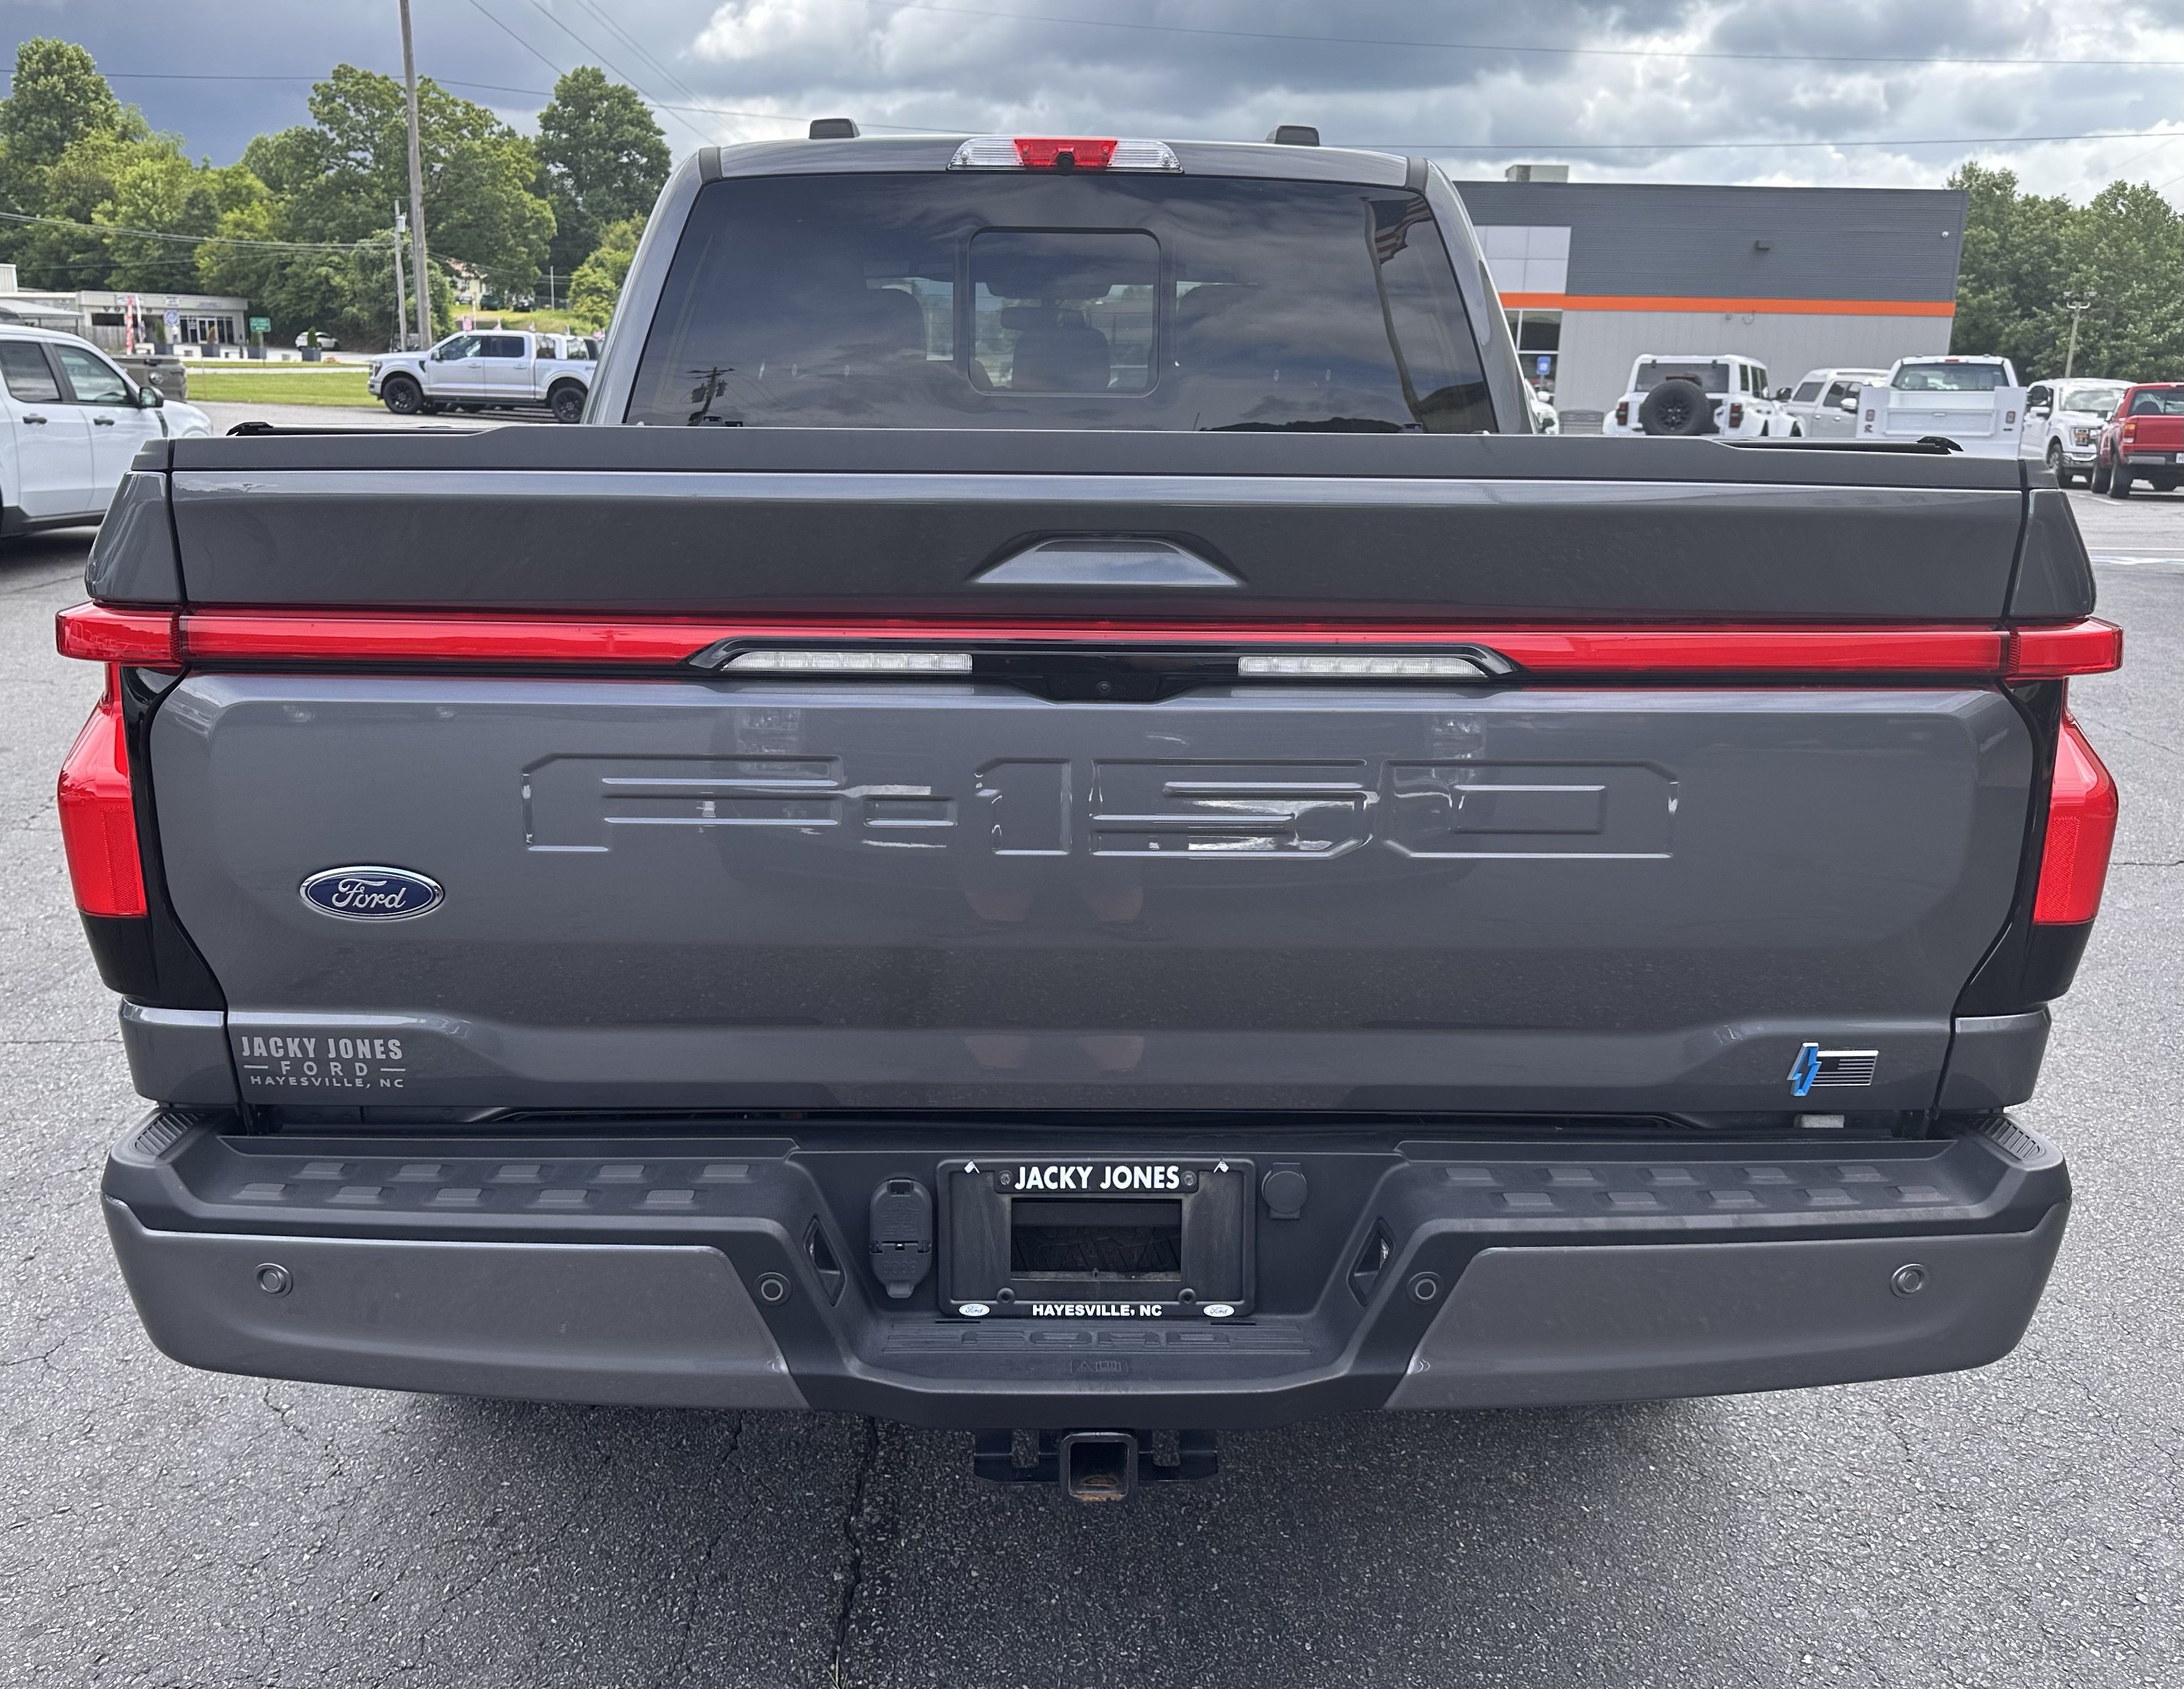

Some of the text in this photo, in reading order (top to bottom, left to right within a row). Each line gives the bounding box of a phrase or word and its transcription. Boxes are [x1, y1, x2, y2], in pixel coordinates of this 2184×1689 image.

[521, 754, 1680, 860] F-150
[331, 878, 407, 909] Ford
[241, 1036, 403, 1060] JACKY JONES
[280, 1060, 369, 1076] FORD
[250, 1076, 404, 1089] HAYESVILLE, NC
[1014, 1165, 1180, 1190] JACKY JONES
[1032, 1304, 1163, 1317] HAYESVILLE, NC
[962, 1330, 1230, 1347] FORD
